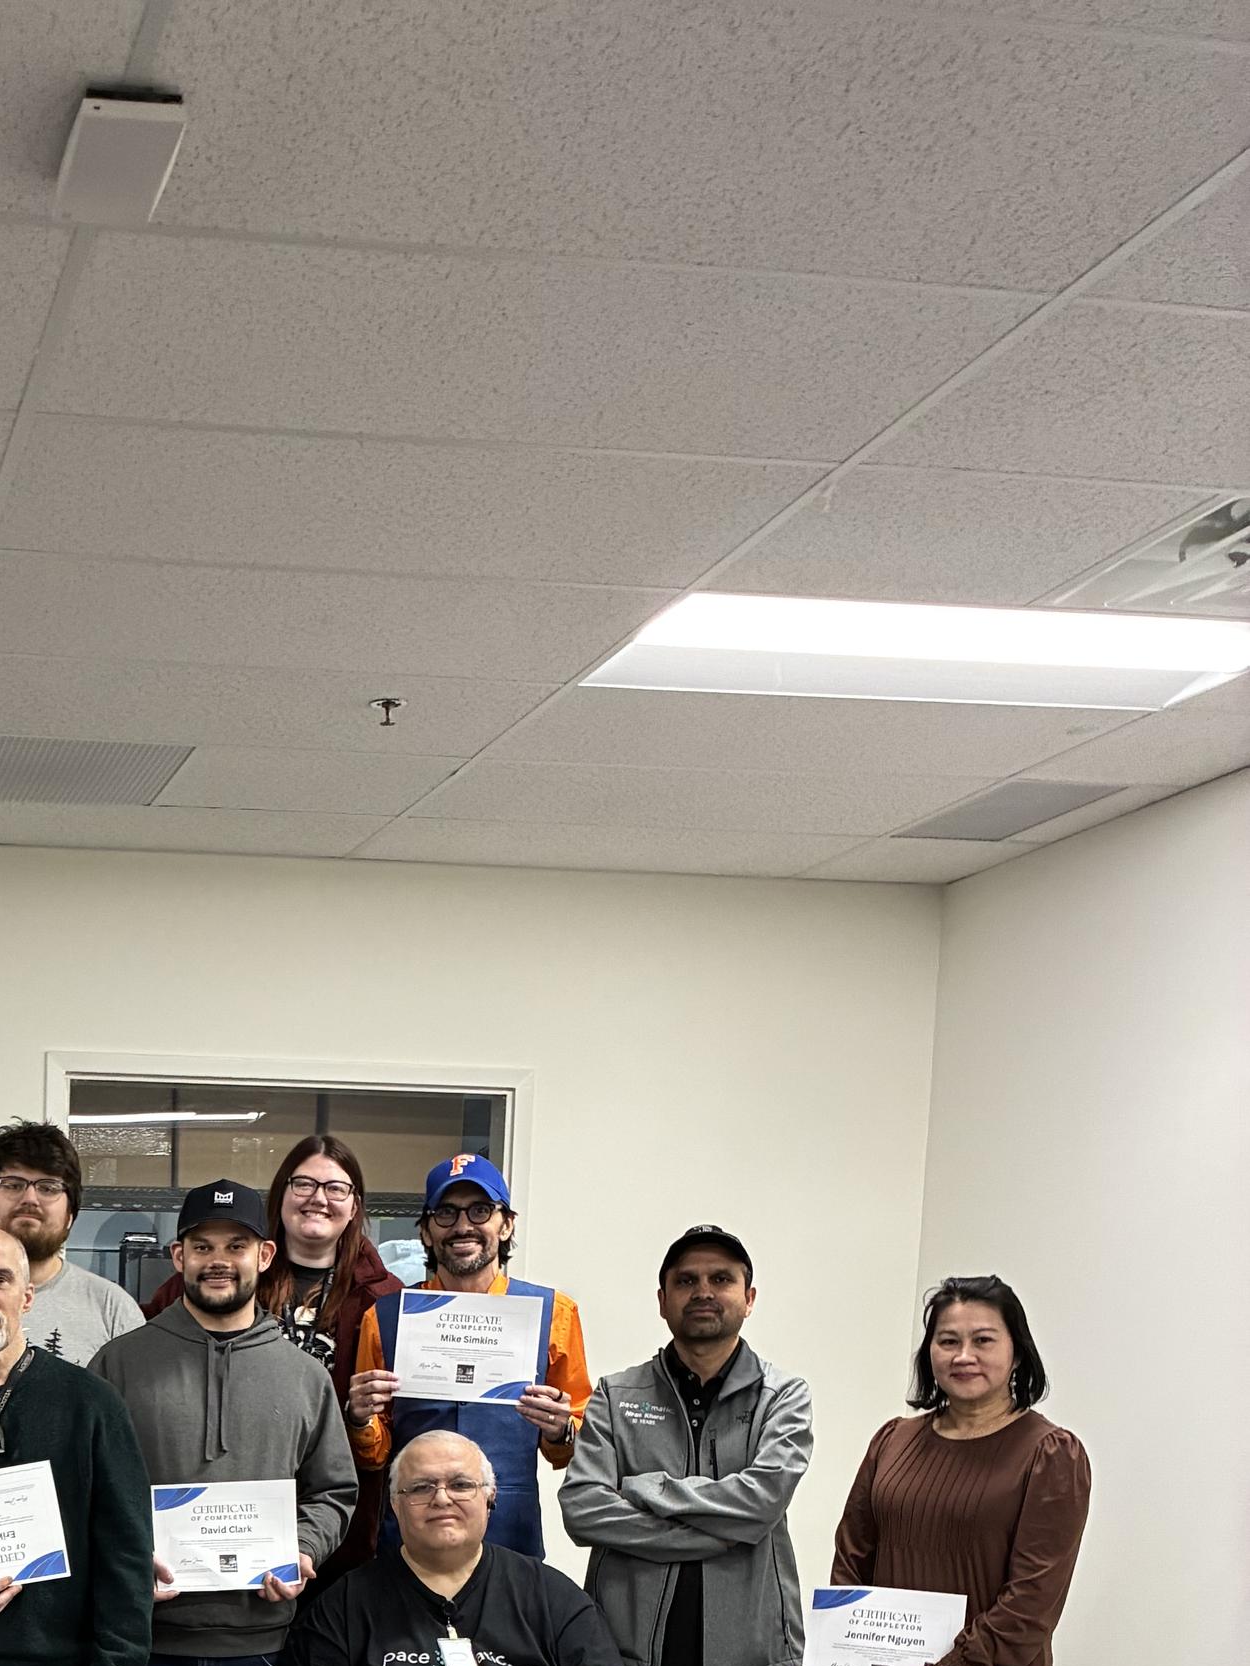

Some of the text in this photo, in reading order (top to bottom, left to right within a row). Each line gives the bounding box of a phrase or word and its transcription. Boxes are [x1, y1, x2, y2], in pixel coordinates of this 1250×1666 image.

[449, 1154, 476, 1176] F
[439, 1313, 502, 1325] CERTIFICATE
[449, 1324, 503, 1332] COMPLETION
[440, 1334, 498, 1345] Mike Simkins
[192, 1504, 257, 1514] CERTIFICATE
[0, 1530, 16, 1540] Erik
[200, 1526, 226, 1534] David
[852, 1608, 921, 1624] CERTIFICATE
[864, 1620, 922, 1631] COMPLETION
[845, 1630, 925, 1646] Jennifer Nguyen
